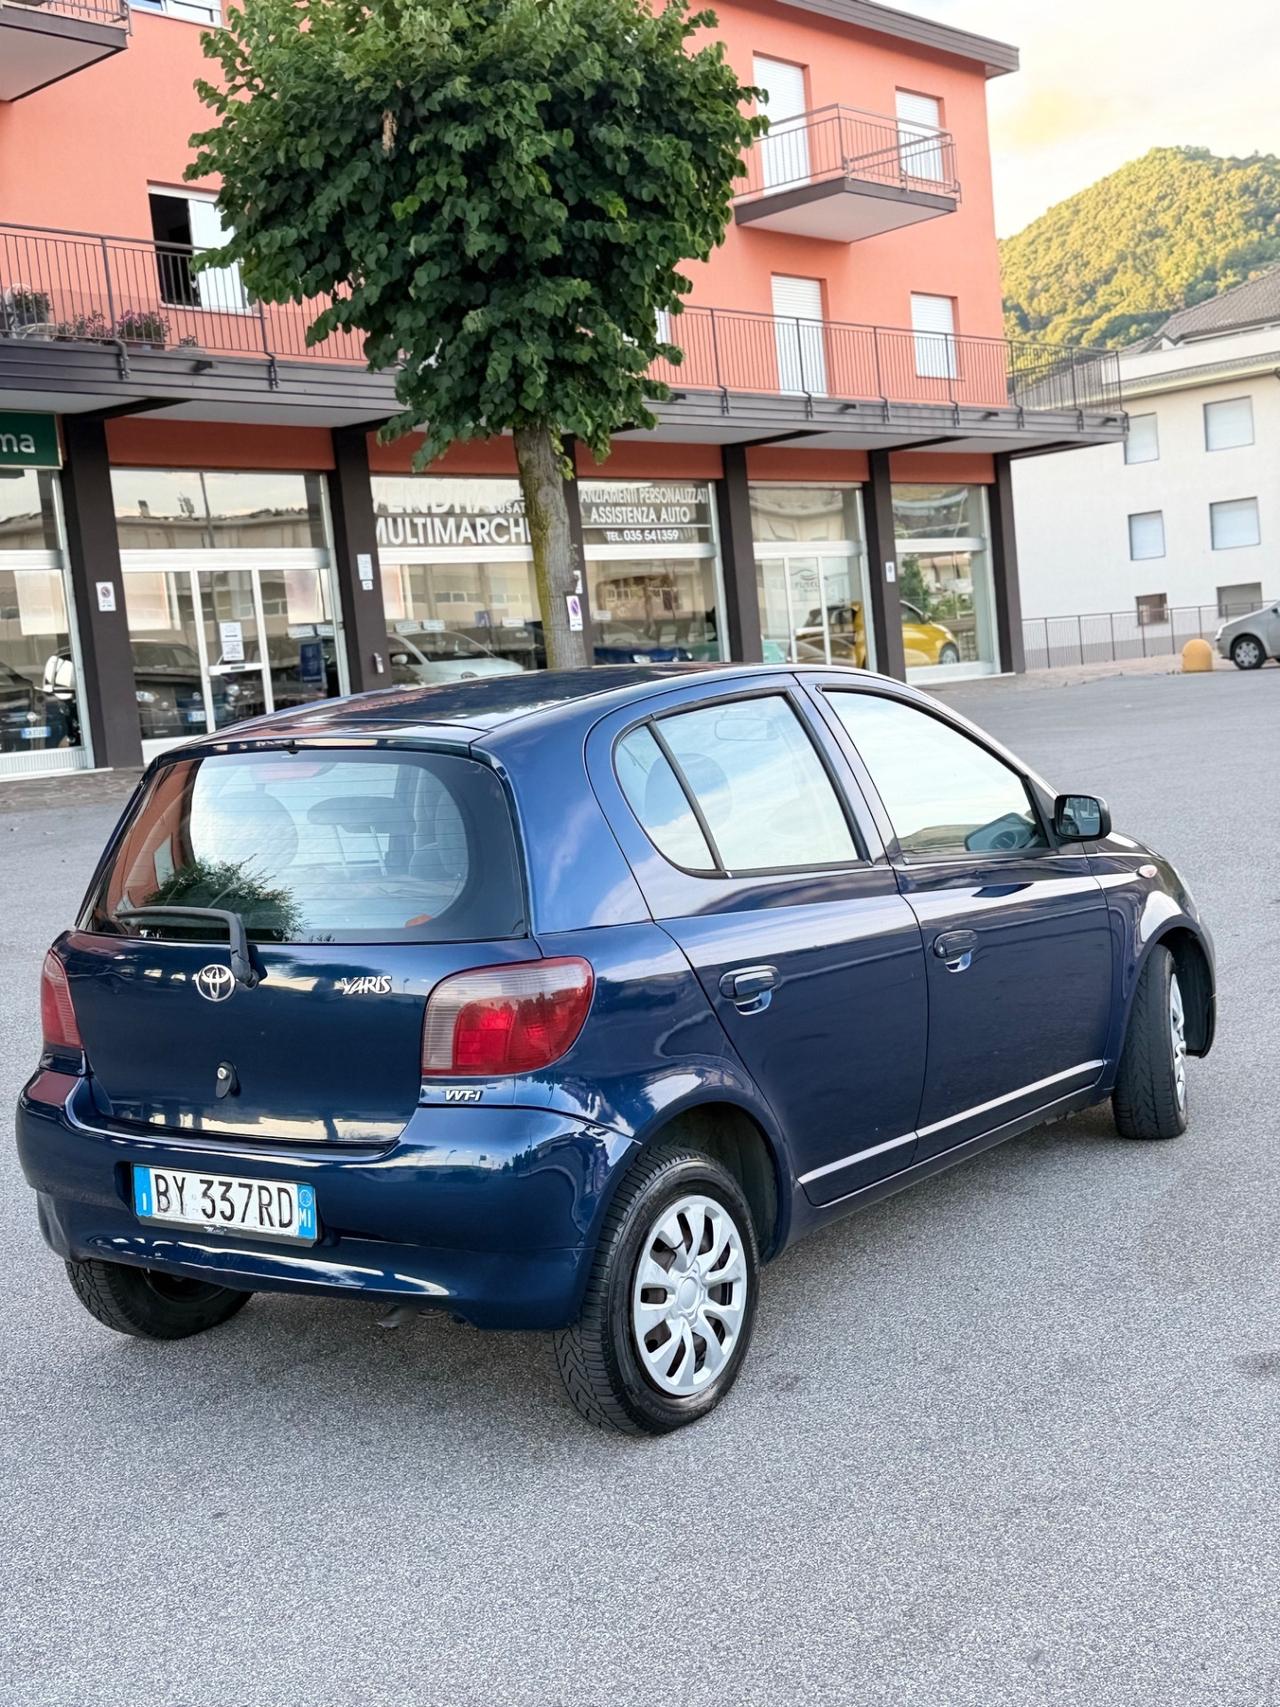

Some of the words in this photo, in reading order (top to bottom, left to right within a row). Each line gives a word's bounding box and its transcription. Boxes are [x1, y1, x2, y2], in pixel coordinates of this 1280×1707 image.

[590, 506, 657, 523] ASSISTENZA
[660, 506, 690, 523] AUTO
[606, 531, 622, 541] TEL.
[624, 530, 643, 541] 035
[644, 529, 679, 541] 541359
[342, 975, 393, 995] YARIS
[154, 1174, 187, 1216] BY
[199, 1179, 293, 1229] 337RD
